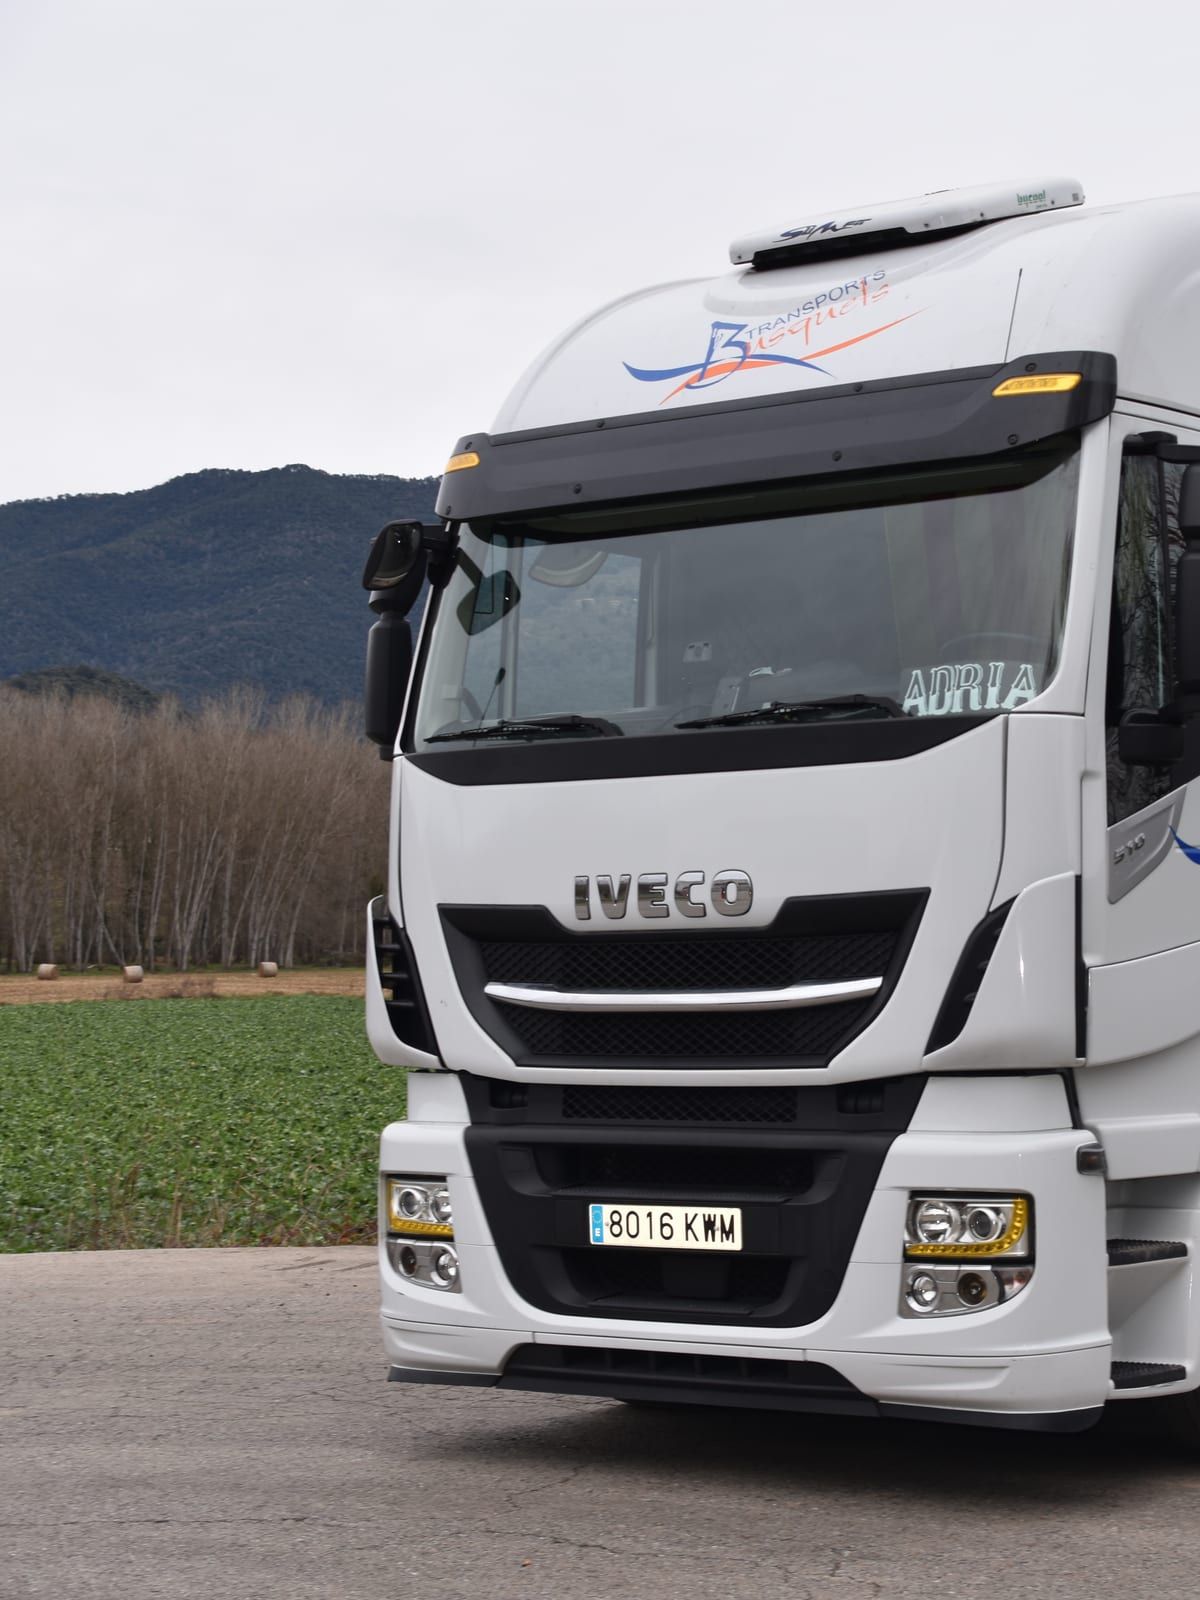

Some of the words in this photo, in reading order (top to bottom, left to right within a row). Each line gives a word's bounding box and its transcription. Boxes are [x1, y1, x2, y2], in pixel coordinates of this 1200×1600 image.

[745, 269, 886, 339] TRANSPORTS
[902, 661, 1037, 717] ADRIA
[573, 868, 754, 921] IVECO
[594, 1227, 602, 1237] E
[609, 1209, 674, 1241] 8016
[684, 1212, 735, 1244] KWM
